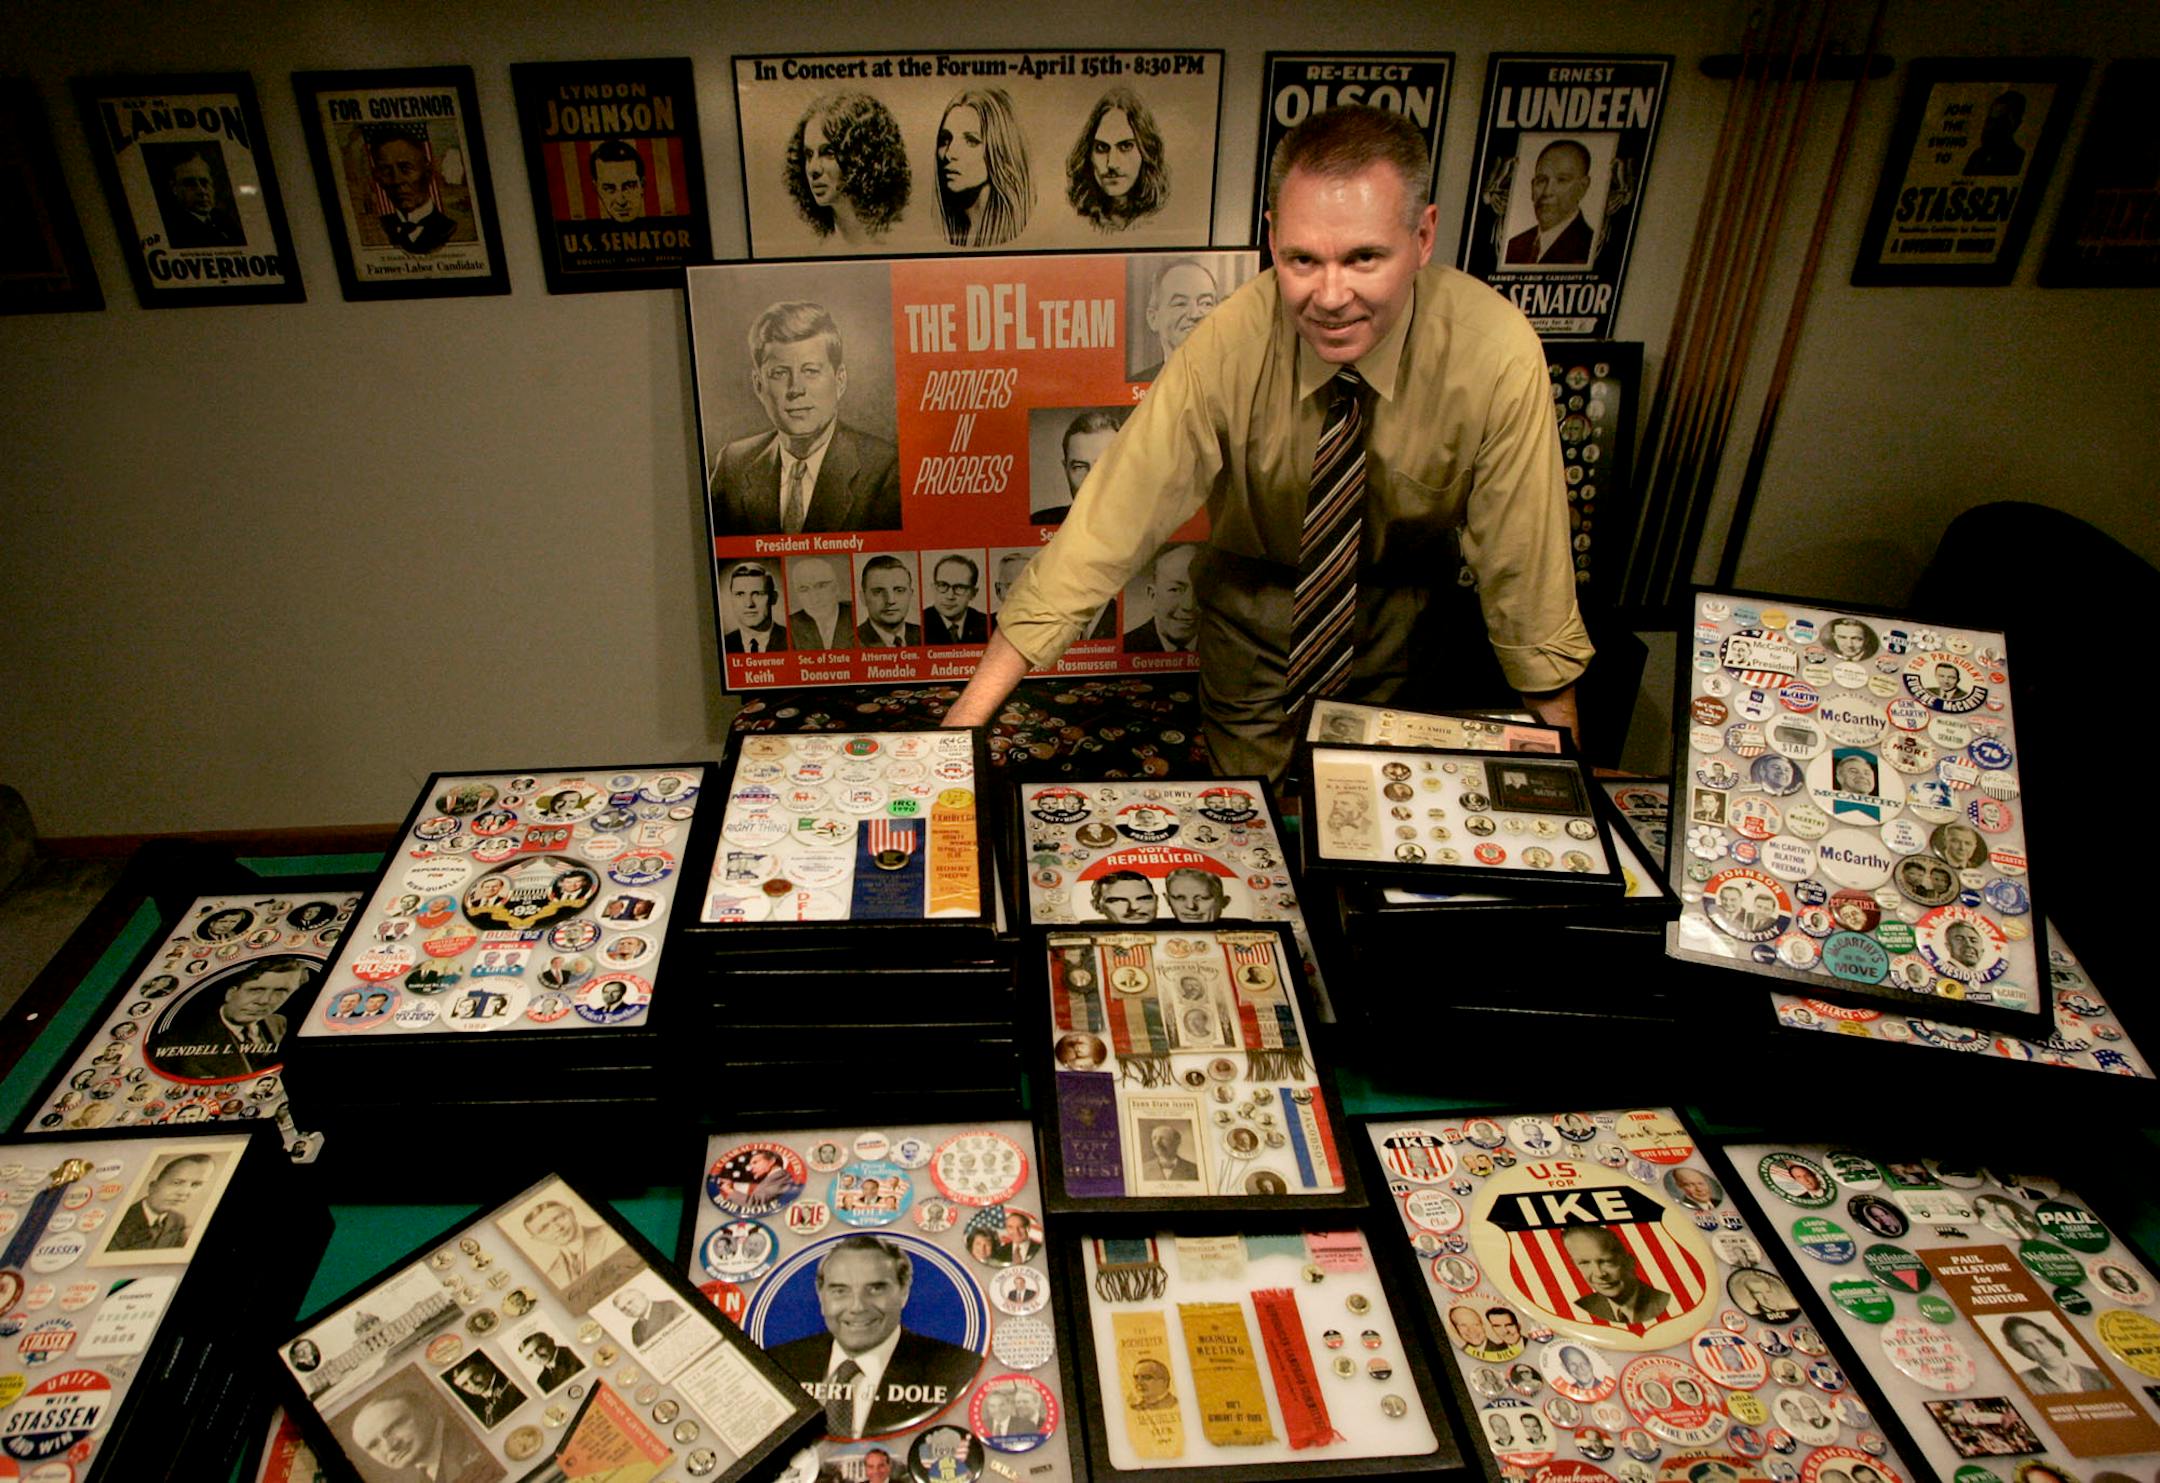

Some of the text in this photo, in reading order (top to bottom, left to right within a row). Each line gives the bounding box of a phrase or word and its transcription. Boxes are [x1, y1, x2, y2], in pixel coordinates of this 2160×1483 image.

[755, 61, 777, 80] In
[781, 59, 867, 80] Concert
[872, 60, 894, 78] at
[899, 58, 932, 77] the
[1081, 55, 1121, 76] 15th
[1133, 57, 1171, 76] 8:30
[1173, 56, 1205, 75] PM
[1306, 64, 1413, 82] RE-ELECT
[1548, 66, 1616, 83] ERNEST
[559, 82, 648, 100] LYNDON
[328, 94, 456, 121] FOR GOVERNOR
[1495, 85, 1656, 130] LUNDEEN
[545, 95, 676, 136] JOHNSON
[101, 103, 249, 153] LANDON
[1895, 186, 2019, 223] STASSEN
[562, 228, 692, 254] U.S. SENATOR
[148, 249, 281, 281] GOVERNOR
[366, 259, 486, 276] Farmer-Labor Candidate
[1510, 284, 1613, 316] SENATOR
[905, 283, 1116, 354] THE DFL TEAM
[919, 367, 1019, 412] PARTNERS
[949, 413, 976, 453] IN
[912, 455, 1014, 496] PROGRESS
[755, 534, 865, 554] President Kennedy
[927, 648, 985, 660] Commissioner
[1752, 641, 1797, 656] McCarthy
[732, 654, 785, 669] Lt. Governor
[798, 651, 851, 666] Sec. of State
[861, 650, 920, 664] Attorney Gen.
[1131, 655, 1185, 670] Governor
[867, 664, 917, 678] Mondale
[930, 663, 977, 678] Anderso
[1057, 657, 1118, 673] Rasmussen
[1751, 660, 1796, 674] President
[1929, 653, 1985, 683] PRESIDENT
[745, 669, 775, 684] Keith
[800, 667, 851, 682] Donovan
[1779, 689, 1820, 703] McCARTHY
[1942, 686, 1988, 714] McCARTHY
[1820, 707, 1887, 730] McCarthy
[1890, 708, 1928, 719] McCARTHY
[1782, 743, 1809, 756] STAFF
[1892, 744, 1928, 759] MORE
[1981, 746, 2002, 760] 76
[1163, 790, 1193, 799] DEWEY
[1813, 787, 1903, 809] McCARTHY
[725, 822, 788, 834] RIGHT THING
[1138, 847, 1171, 855] VOTE
[1106, 853, 1205, 866] REPUBLICAN
[1820, 847, 1890, 873] McCarthy
[1770, 861, 1808, 876] FREEMAN
[1716, 866, 1784, 895] JOHNSON
[512, 904, 539, 917] 92
[1928, 911, 2001, 942] McCARTHY
[486, 930, 521, 942] BUSH
[1830, 935, 1885, 963] McCARTHY'S
[355, 963, 401, 975] BUSH
[1834, 962, 1878, 978] MOVE
[1932, 960, 1991, 982] PRESIDENT
[1913, 1020, 1991, 1052] FOR PRESIDENT
[155, 1044, 220, 1059] WENDELL
[222, 1043, 236, 1055] L.
[1627, 1113, 1657, 1122] THINK
[1303, 1108, 1326, 1167] JACOBSON
[1393, 1136, 1434, 1149] IKE
[1670, 1147, 1689, 1158] IKE
[1526, 1161, 1583, 1181] U.S.
[1548, 1178, 1576, 1188] FOR
[713, 1193, 781, 1216] BOB DOLE
[851, 1206, 888, 1217] DOLE
[1515, 1190, 1634, 1227] IKE
[2036, 1210, 2099, 1226] PAUL
[36, 1243, 82, 1257] STASSEN
[2022, 1249, 2075, 1262] Wellstone
[1865, 1252, 1919, 1265] Wellstone
[1949, 1254, 1985, 1266] PAUL
[1937, 1263, 2013, 1277] WELLSTONE
[1972, 1274, 1992, 1285] for
[1970, 1283, 2012, 1295] STATE
[1970, 1293, 2029, 1306] AUDITOR
[1766, 1311, 1789, 1321] DICK
[20, 1332, 76, 1353] STASSEN
[1883, 1334, 1951, 1347] WELLSTONE
[1195, 1344, 1245, 1357] MEETING
[1905, 1354, 1962, 1366] PRESIDENT
[1626, 1358, 1682, 1390] INAUGURATION
[46, 1373, 98, 1393] UNITE
[44, 1395, 80, 1406] WITH
[887, 1382, 948, 1405] DOLE
[1492, 1397, 1519, 1408] VOTE
[1742, 1407, 1760, 1415] IKE
[6, 1405, 100, 1434] STASSEN
[39, 1430, 74, 1456] WIN
[1685, 1430, 1701, 1442] IKE
[1534, 1464, 1611, 1483] Eisenhower
